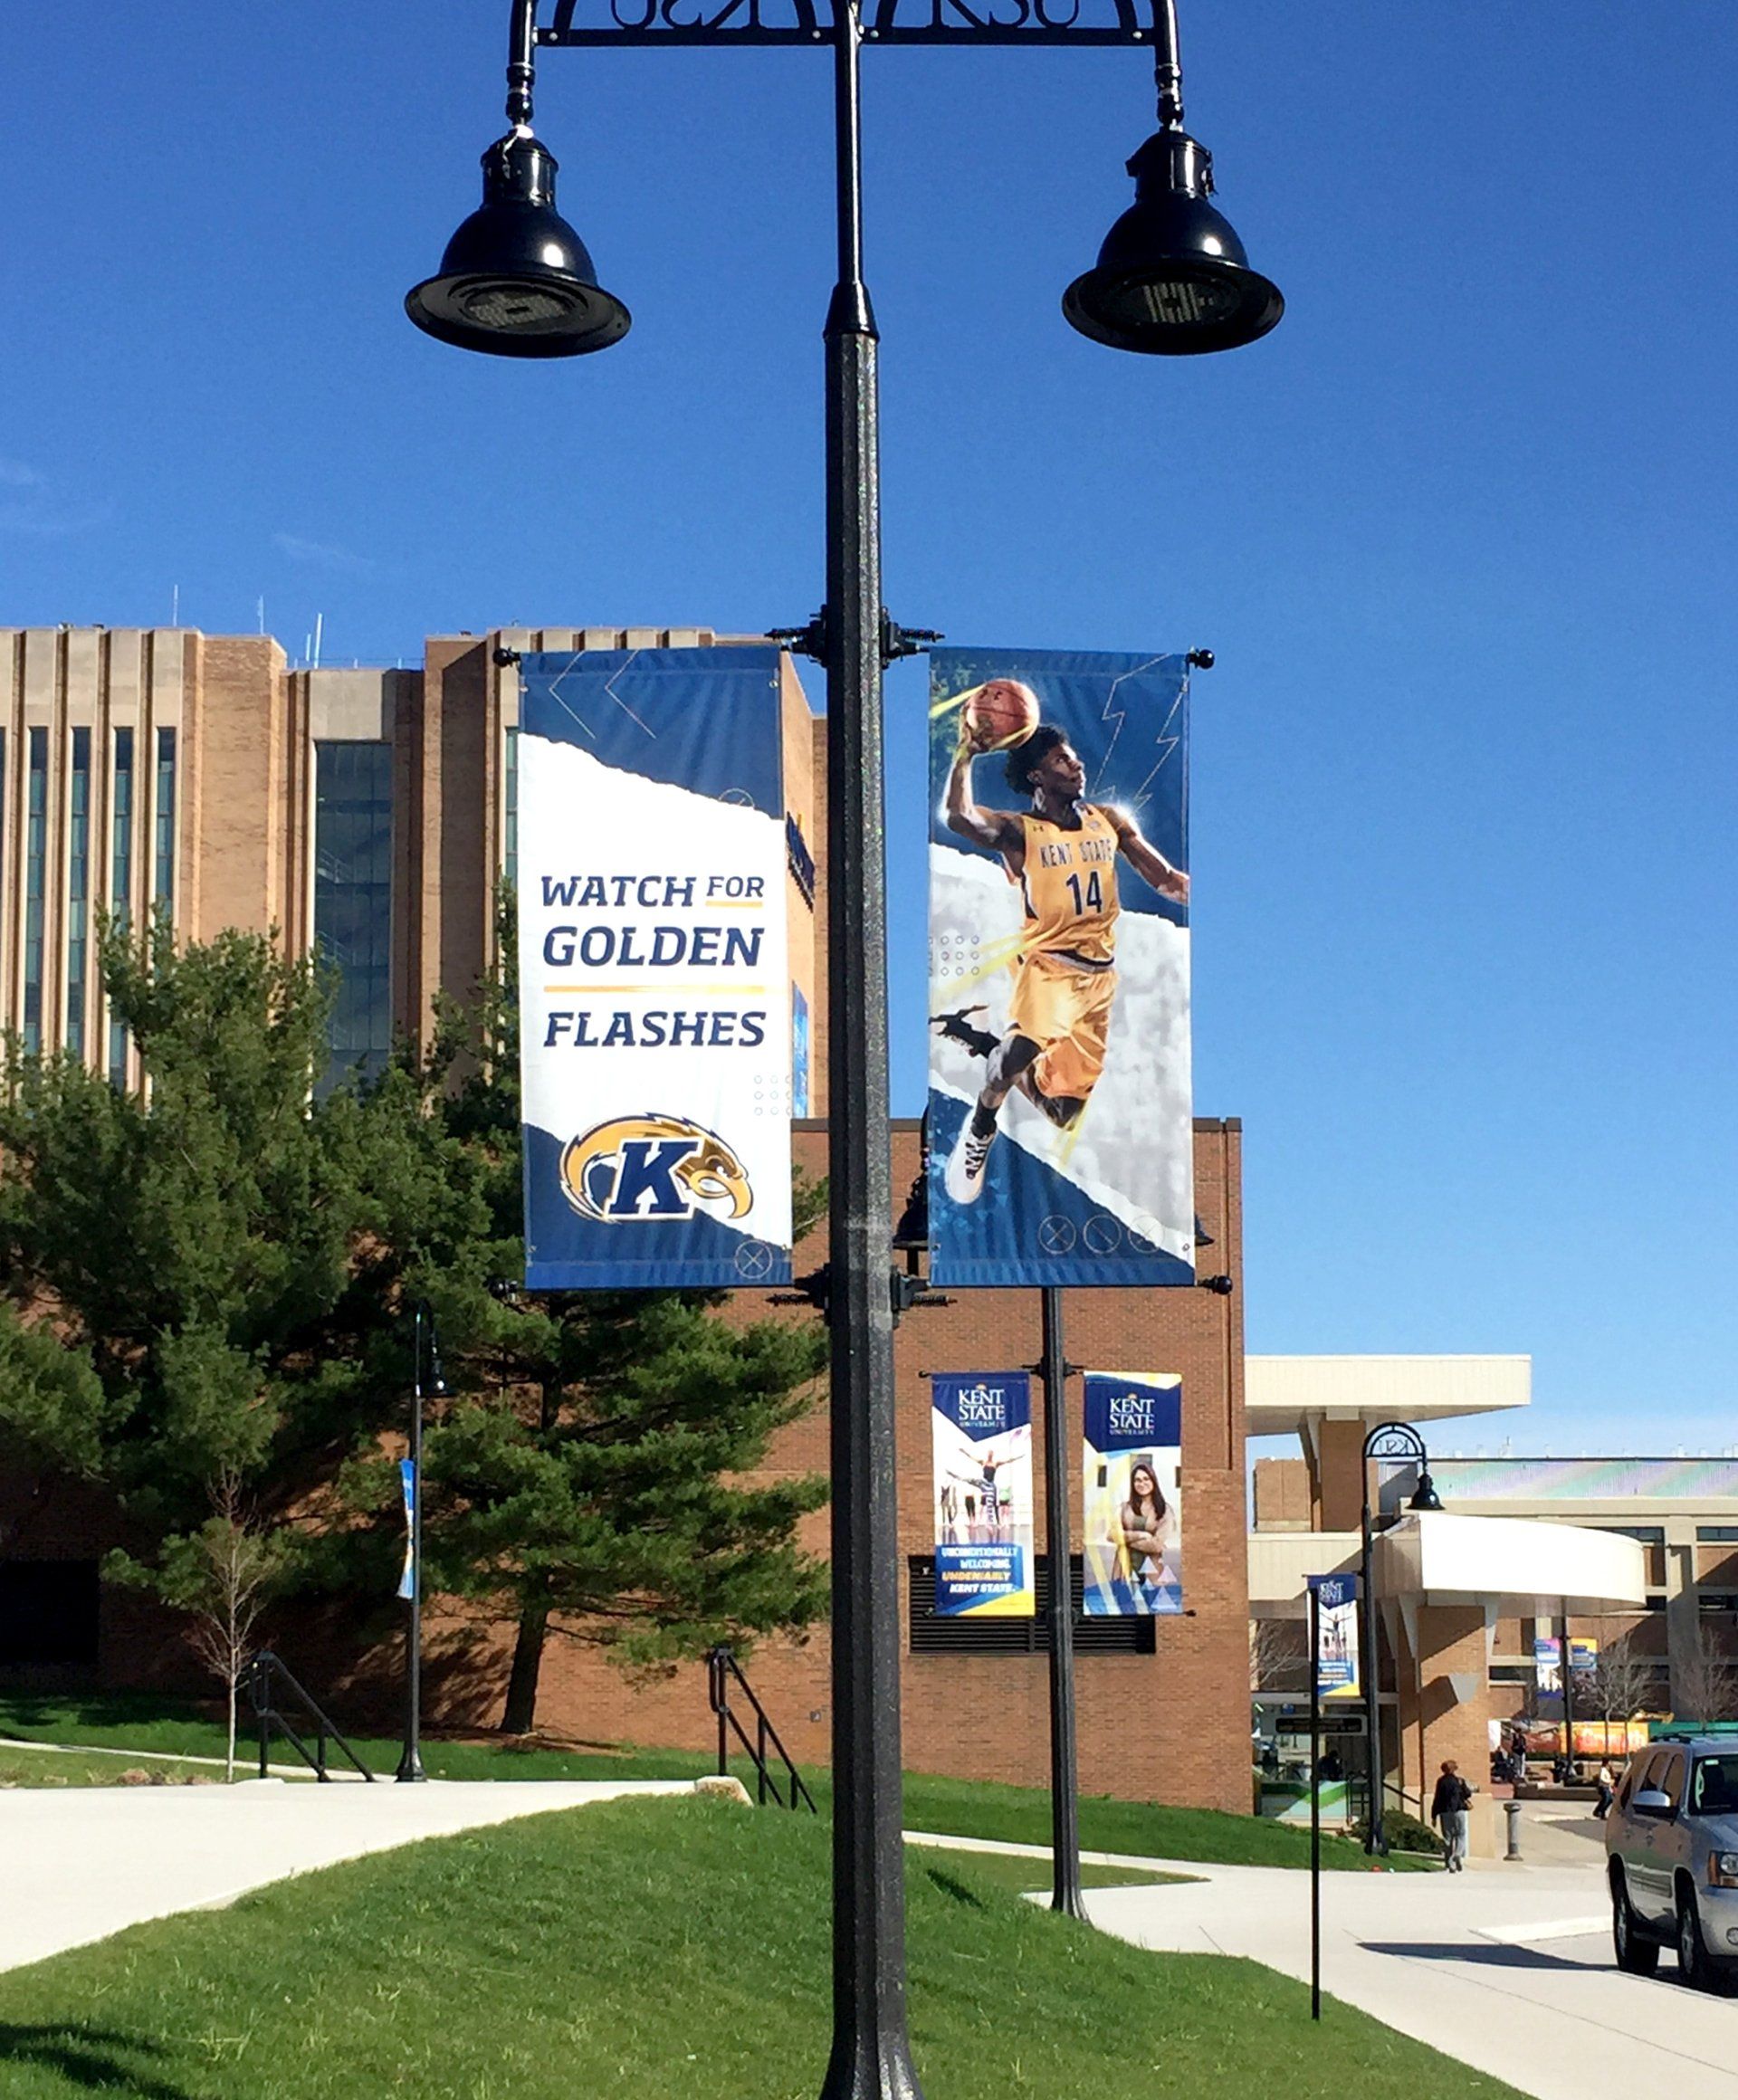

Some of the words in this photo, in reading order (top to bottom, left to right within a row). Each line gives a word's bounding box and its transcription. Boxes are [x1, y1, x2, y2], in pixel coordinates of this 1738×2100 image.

[1040, 843, 1073, 868] KENT
[1079, 838, 1113, 863] STATE
[540, 875, 697, 908] WATCH
[706, 875, 765, 898] FOR
[1065, 871, 1103, 916] 14
[542, 925, 765, 967] GOLDEN
[542, 1010, 767, 1047] FLASHES
[607, 1139, 701, 1217] K
[959, 1389, 1005, 1404] KENT
[1110, 1398, 1155, 1413] KENT
[959, 1405, 1006, 1420] STATE
[1109, 1413, 1155, 1429] STATE
